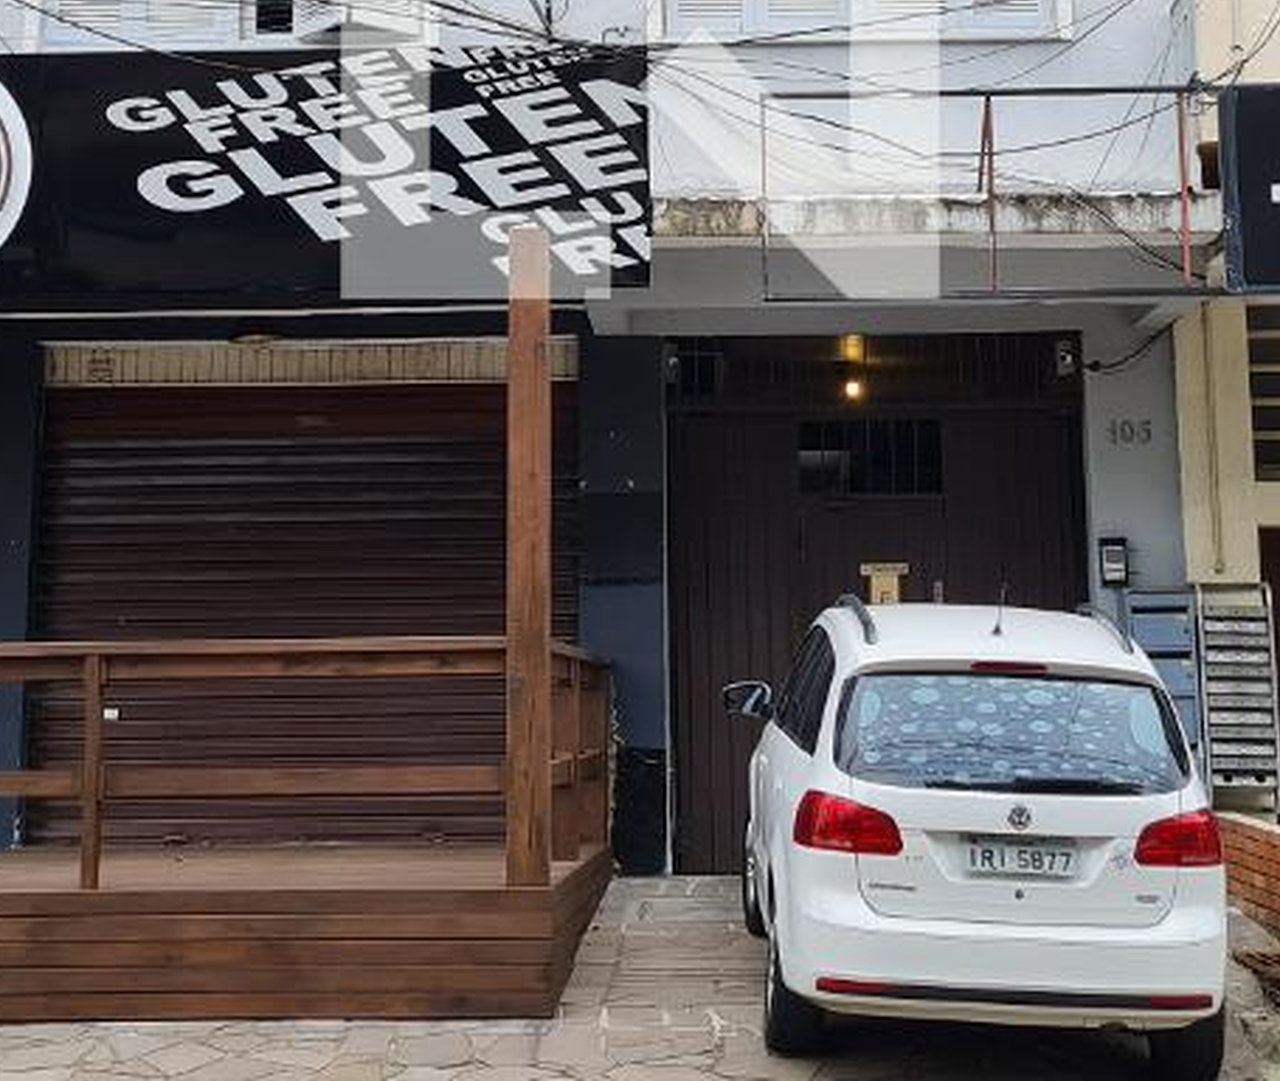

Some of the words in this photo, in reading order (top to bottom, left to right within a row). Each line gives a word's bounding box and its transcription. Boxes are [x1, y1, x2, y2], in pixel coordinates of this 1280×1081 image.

[180, 74, 429, 154] FREE
[285, 132, 648, 242] FREE
[1017, 848, 1072, 872] 5877
